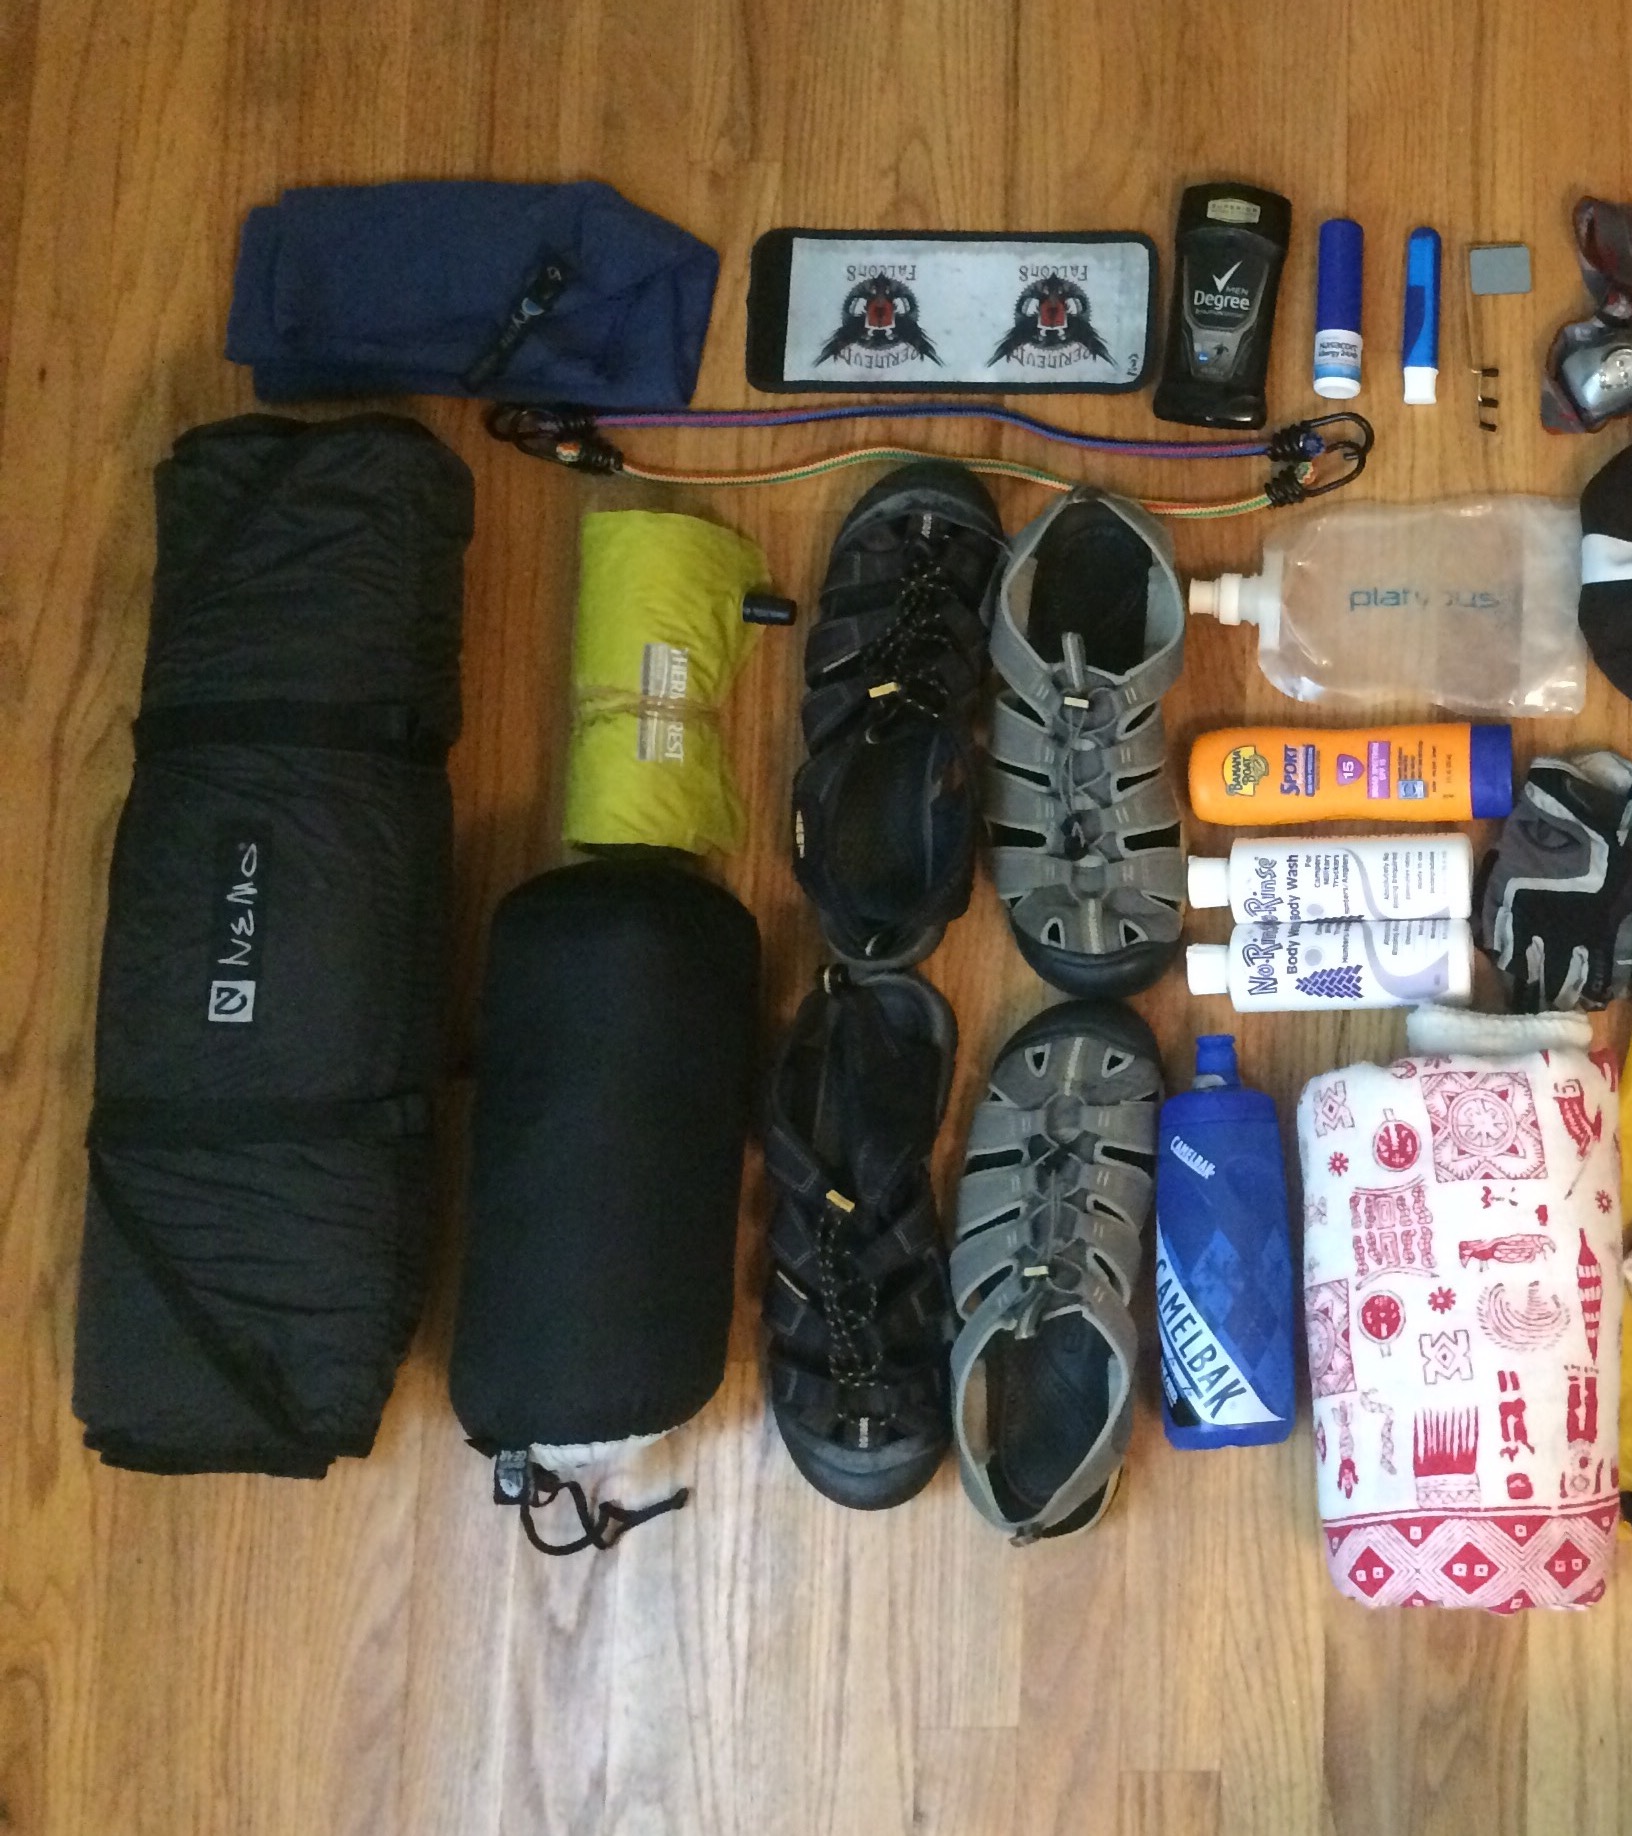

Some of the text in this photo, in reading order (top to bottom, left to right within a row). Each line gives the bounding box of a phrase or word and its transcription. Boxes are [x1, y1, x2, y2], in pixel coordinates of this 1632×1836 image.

[1193, 290, 1250, 311] Degree
[1280, 743, 1300, 796] SPORT
[1342, 760, 1355, 779] 15
[1286, 854, 1299, 890] Wash
[217, 842, 258, 966] NEMO
[1286, 940, 1301, 975] Body
[1170, 1134, 1217, 1180] CAMELBAK
[1156, 1257, 1247, 1420] CAMELBAK
